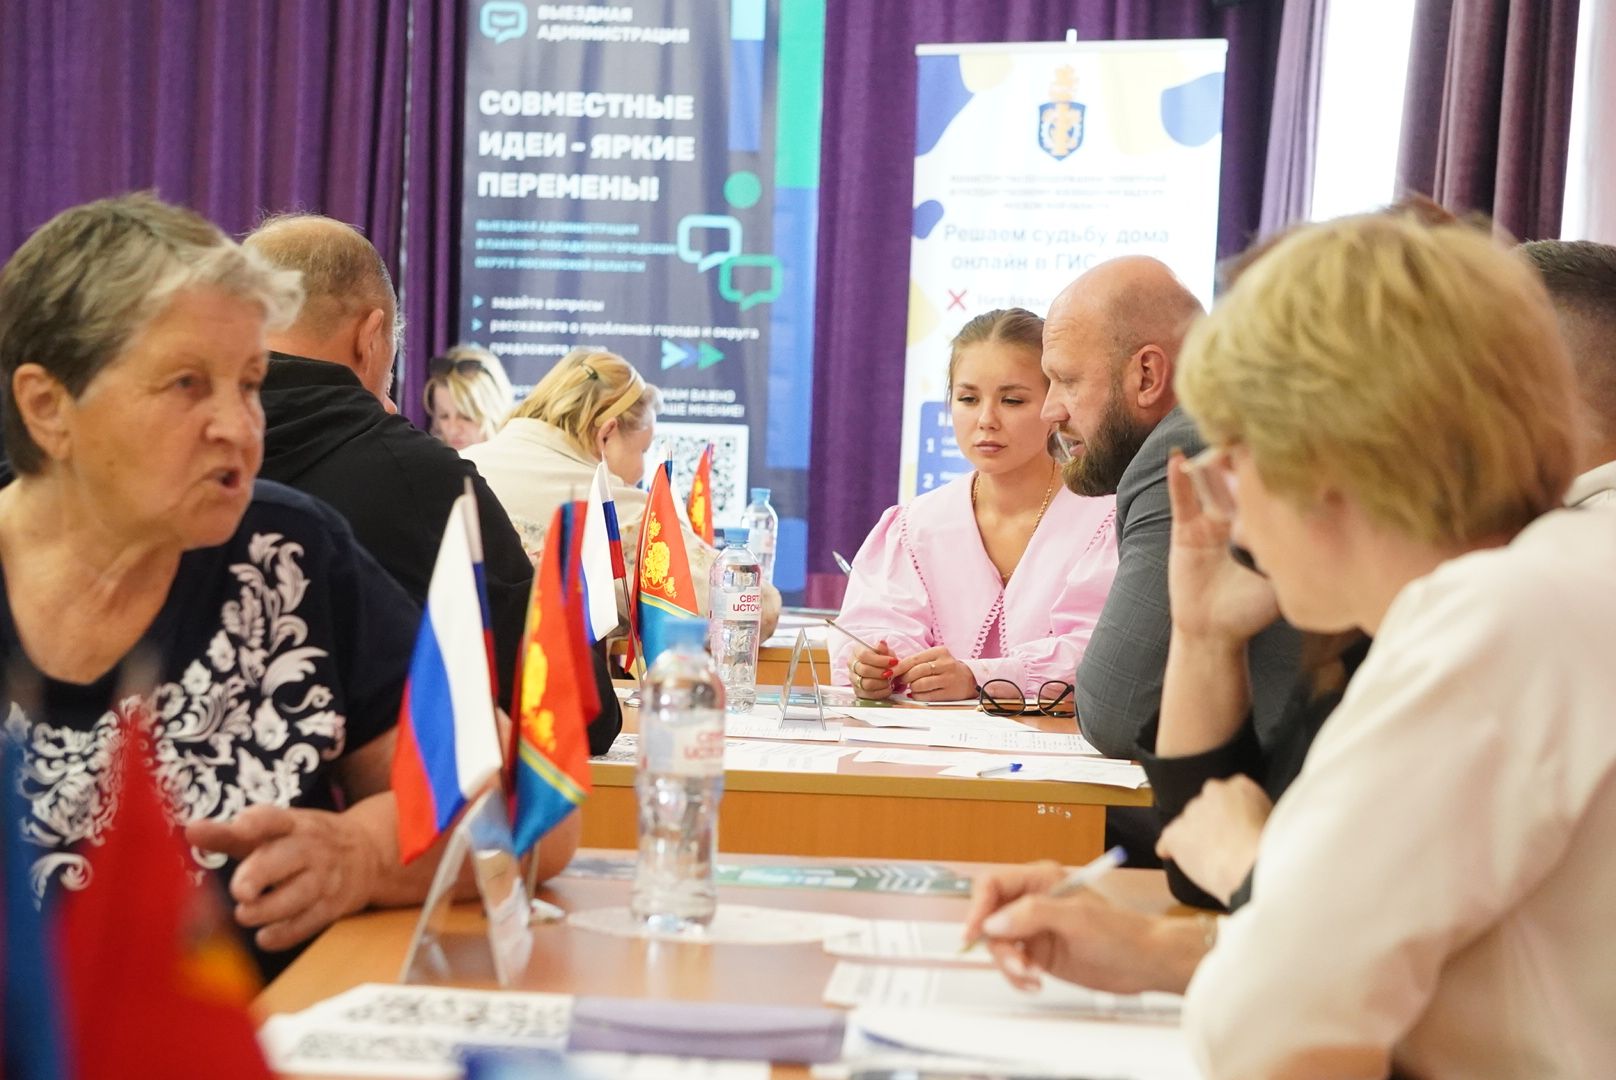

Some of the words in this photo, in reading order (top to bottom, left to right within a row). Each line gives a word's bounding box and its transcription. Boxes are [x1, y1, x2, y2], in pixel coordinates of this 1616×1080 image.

[537, 4, 633, 23] ВЫЕЗДНАЯ
[537, 25, 690, 45] АДМИНИСТРАЦИЯ
[478, 89, 695, 121] СОВМЕСТНЫЕ
[478, 130, 567, 161] ИДЕИ
[590, 133, 696, 162] ЯРКИЕ
[476, 171, 660, 202] ПЕРЕМЕНЫ!
[943, 224, 1026, 243] Решаем
[1031, 225, 1109, 246] судьбу
[1115, 228, 1170, 244] дома
[950, 253, 1029, 271] онлайн
[1035, 257, 1048, 271] в
[1055, 253, 1097, 271] ГИС
[491, 295, 544, 311] задайте
[546, 298, 605, 313] вопросы
[689, 388, 737, 403] ВАЖНО
[926, 437, 935, 453] 1
[922, 472, 934, 489] 2
